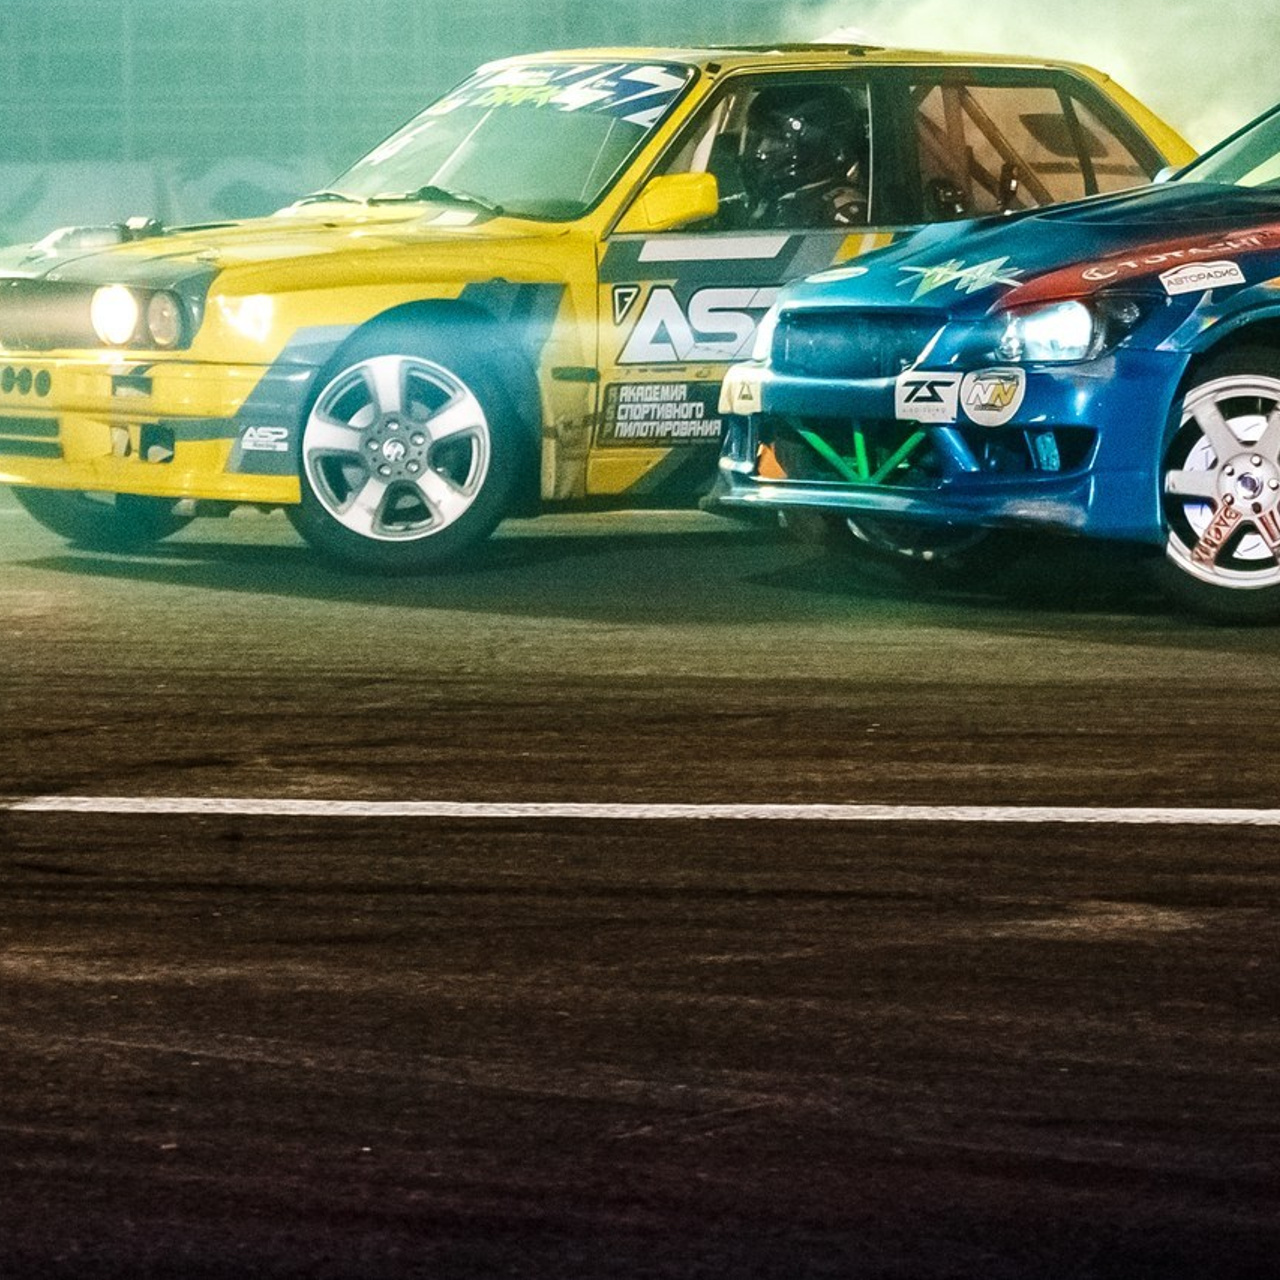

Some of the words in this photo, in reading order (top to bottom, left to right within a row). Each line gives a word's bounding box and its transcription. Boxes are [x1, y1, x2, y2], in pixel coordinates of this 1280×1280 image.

[1166, 267, 1240, 288] АВТОРАДИО
[616, 287, 780, 363] AS
[619, 385, 687, 402] АКАДЕМИЯ
[966, 383, 1018, 407] NN
[617, 402, 704, 420] СПОРТИВНОГО
[614, 420, 722, 438] ПИЛОТИРОВАНИЯ
